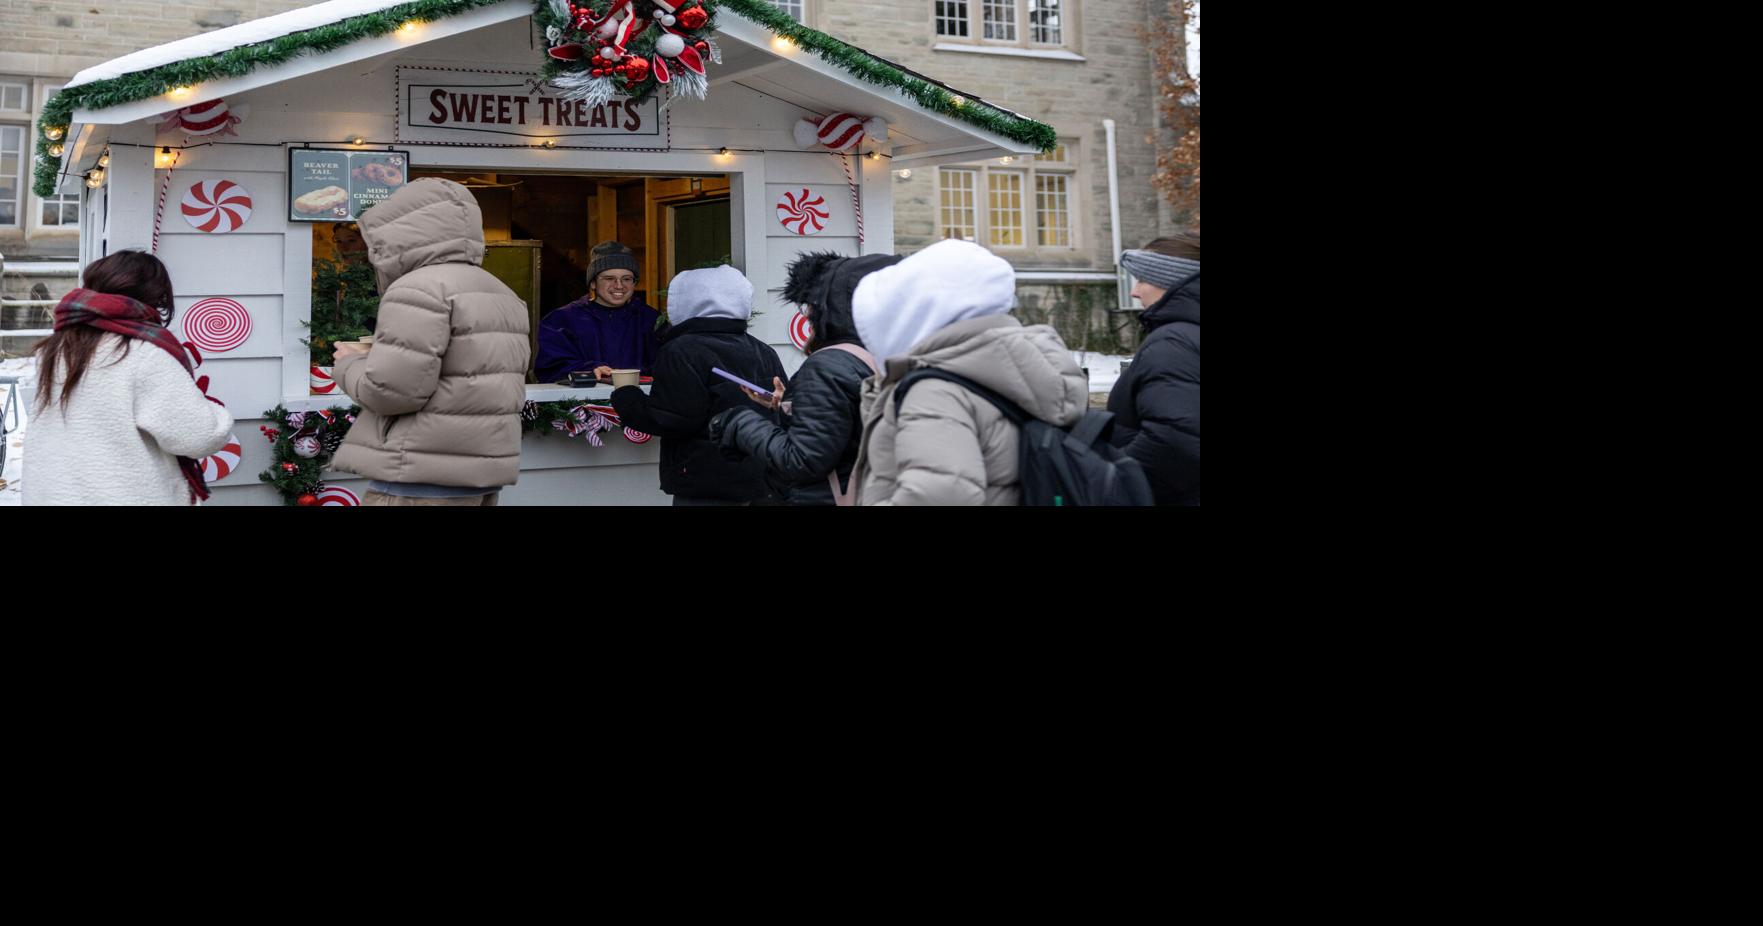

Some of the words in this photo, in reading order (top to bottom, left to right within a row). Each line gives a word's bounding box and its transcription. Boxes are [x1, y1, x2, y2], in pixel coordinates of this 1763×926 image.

[428, 88, 530, 126] SWEET
[538, 94, 642, 132] TREATS
[390, 156, 402, 166] $5
[334, 207, 346, 216] $5
